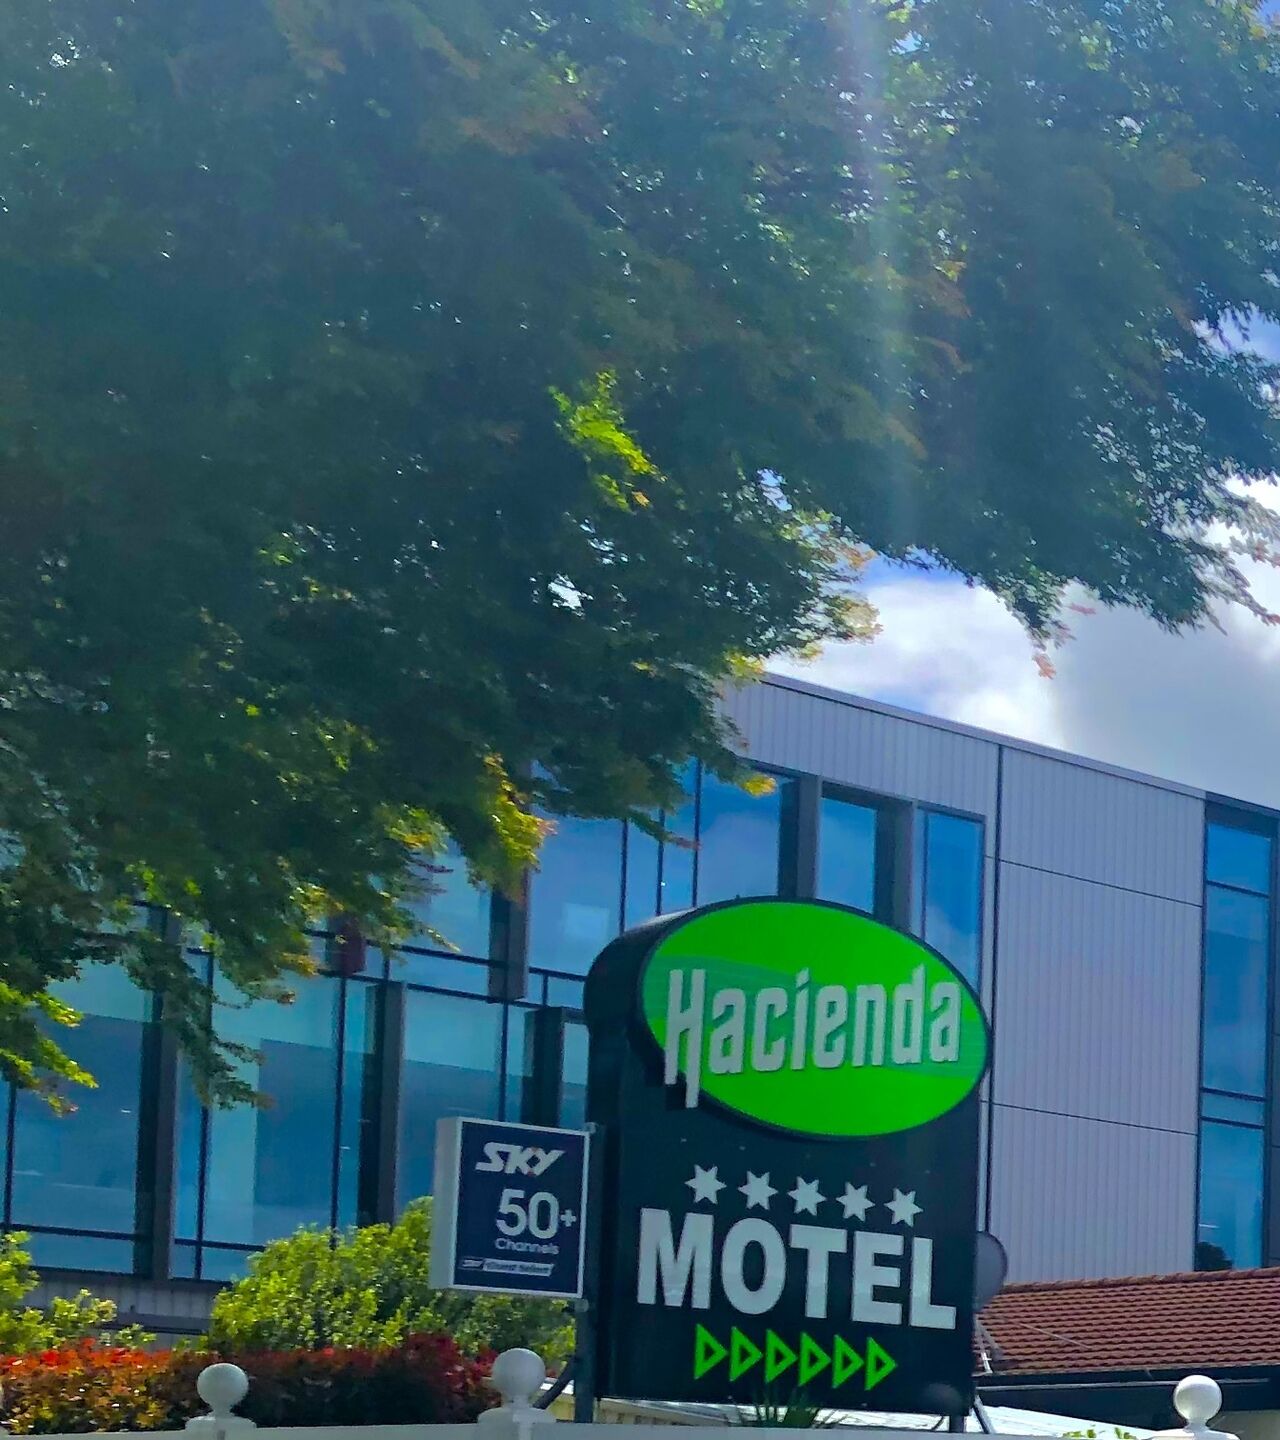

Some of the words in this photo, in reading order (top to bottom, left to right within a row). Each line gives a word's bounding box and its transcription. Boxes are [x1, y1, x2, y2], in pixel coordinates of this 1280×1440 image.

[664, 963, 962, 1109] Hacienda
[475, 1141, 566, 1177] SKY
[496, 1188, 577, 1239] 50+
[637, 1207, 956, 1330] MOTEL
